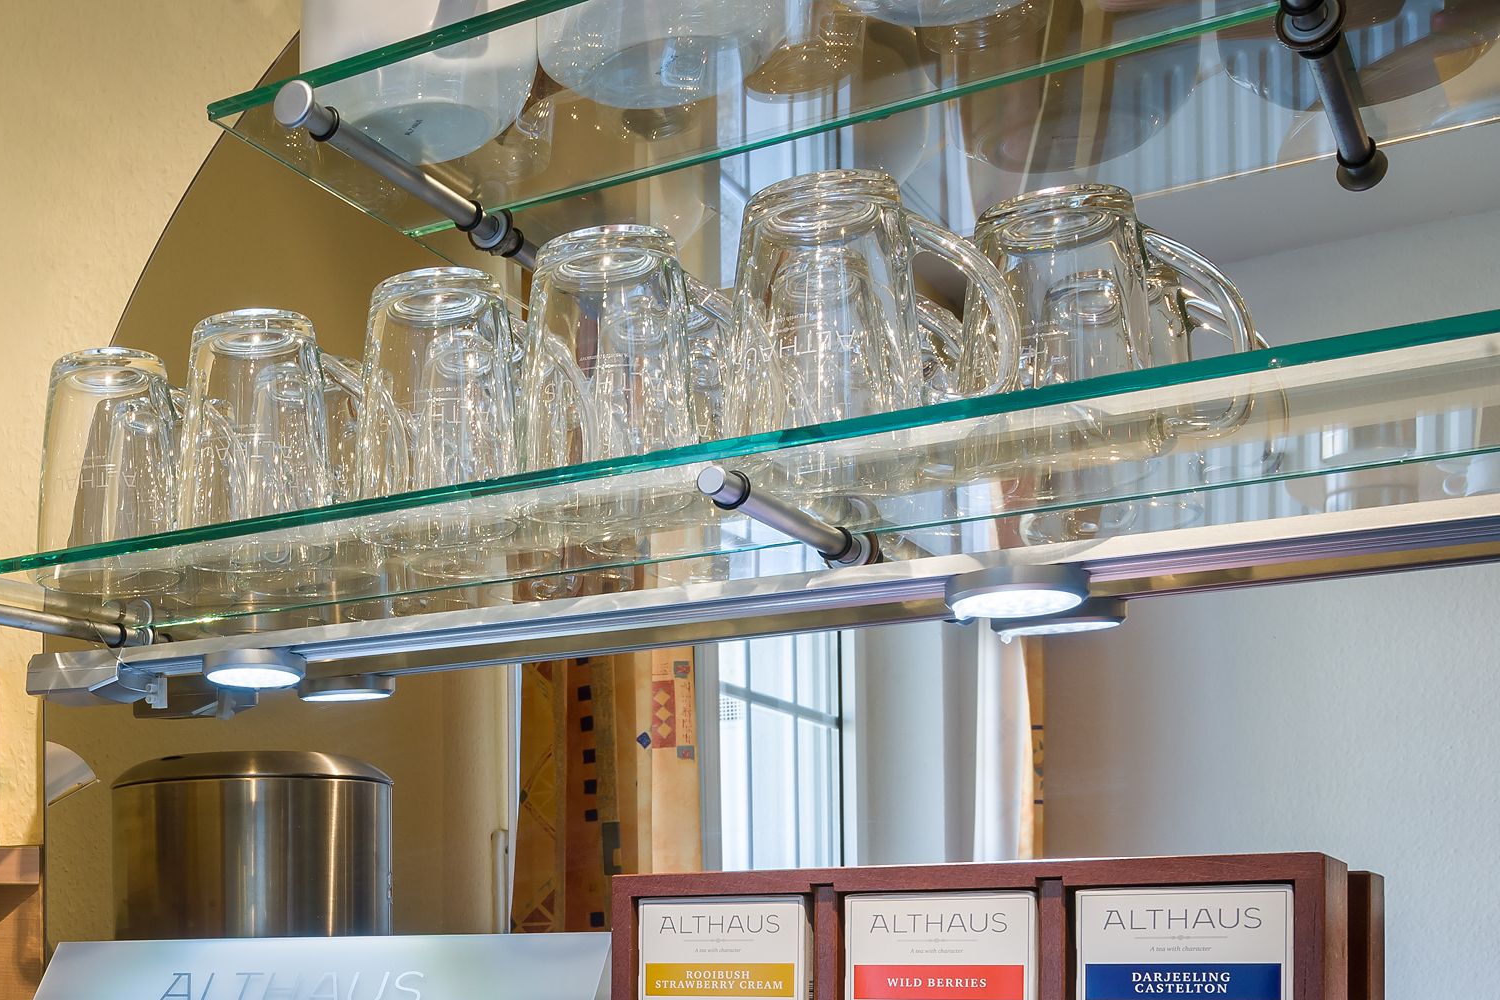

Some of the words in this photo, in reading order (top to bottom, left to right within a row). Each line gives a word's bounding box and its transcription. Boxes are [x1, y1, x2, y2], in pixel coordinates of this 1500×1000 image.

[659, 914, 781, 935] ALTHAUS
[870, 912, 1008, 934] ALTHAUS
[1102, 907, 1263, 931] ALTHAUS
[685, 970, 751, 980] ROOIBUSH
[1131, 971, 1231, 983] DARJEELING
[655, 980, 736, 989] STRAWBERRY
[739, 980, 783, 990] CREAM
[887, 977, 923, 987] WILD
[927, 977, 988, 988] BERRIES
[1134, 983, 1228, 994] CASTELTON
